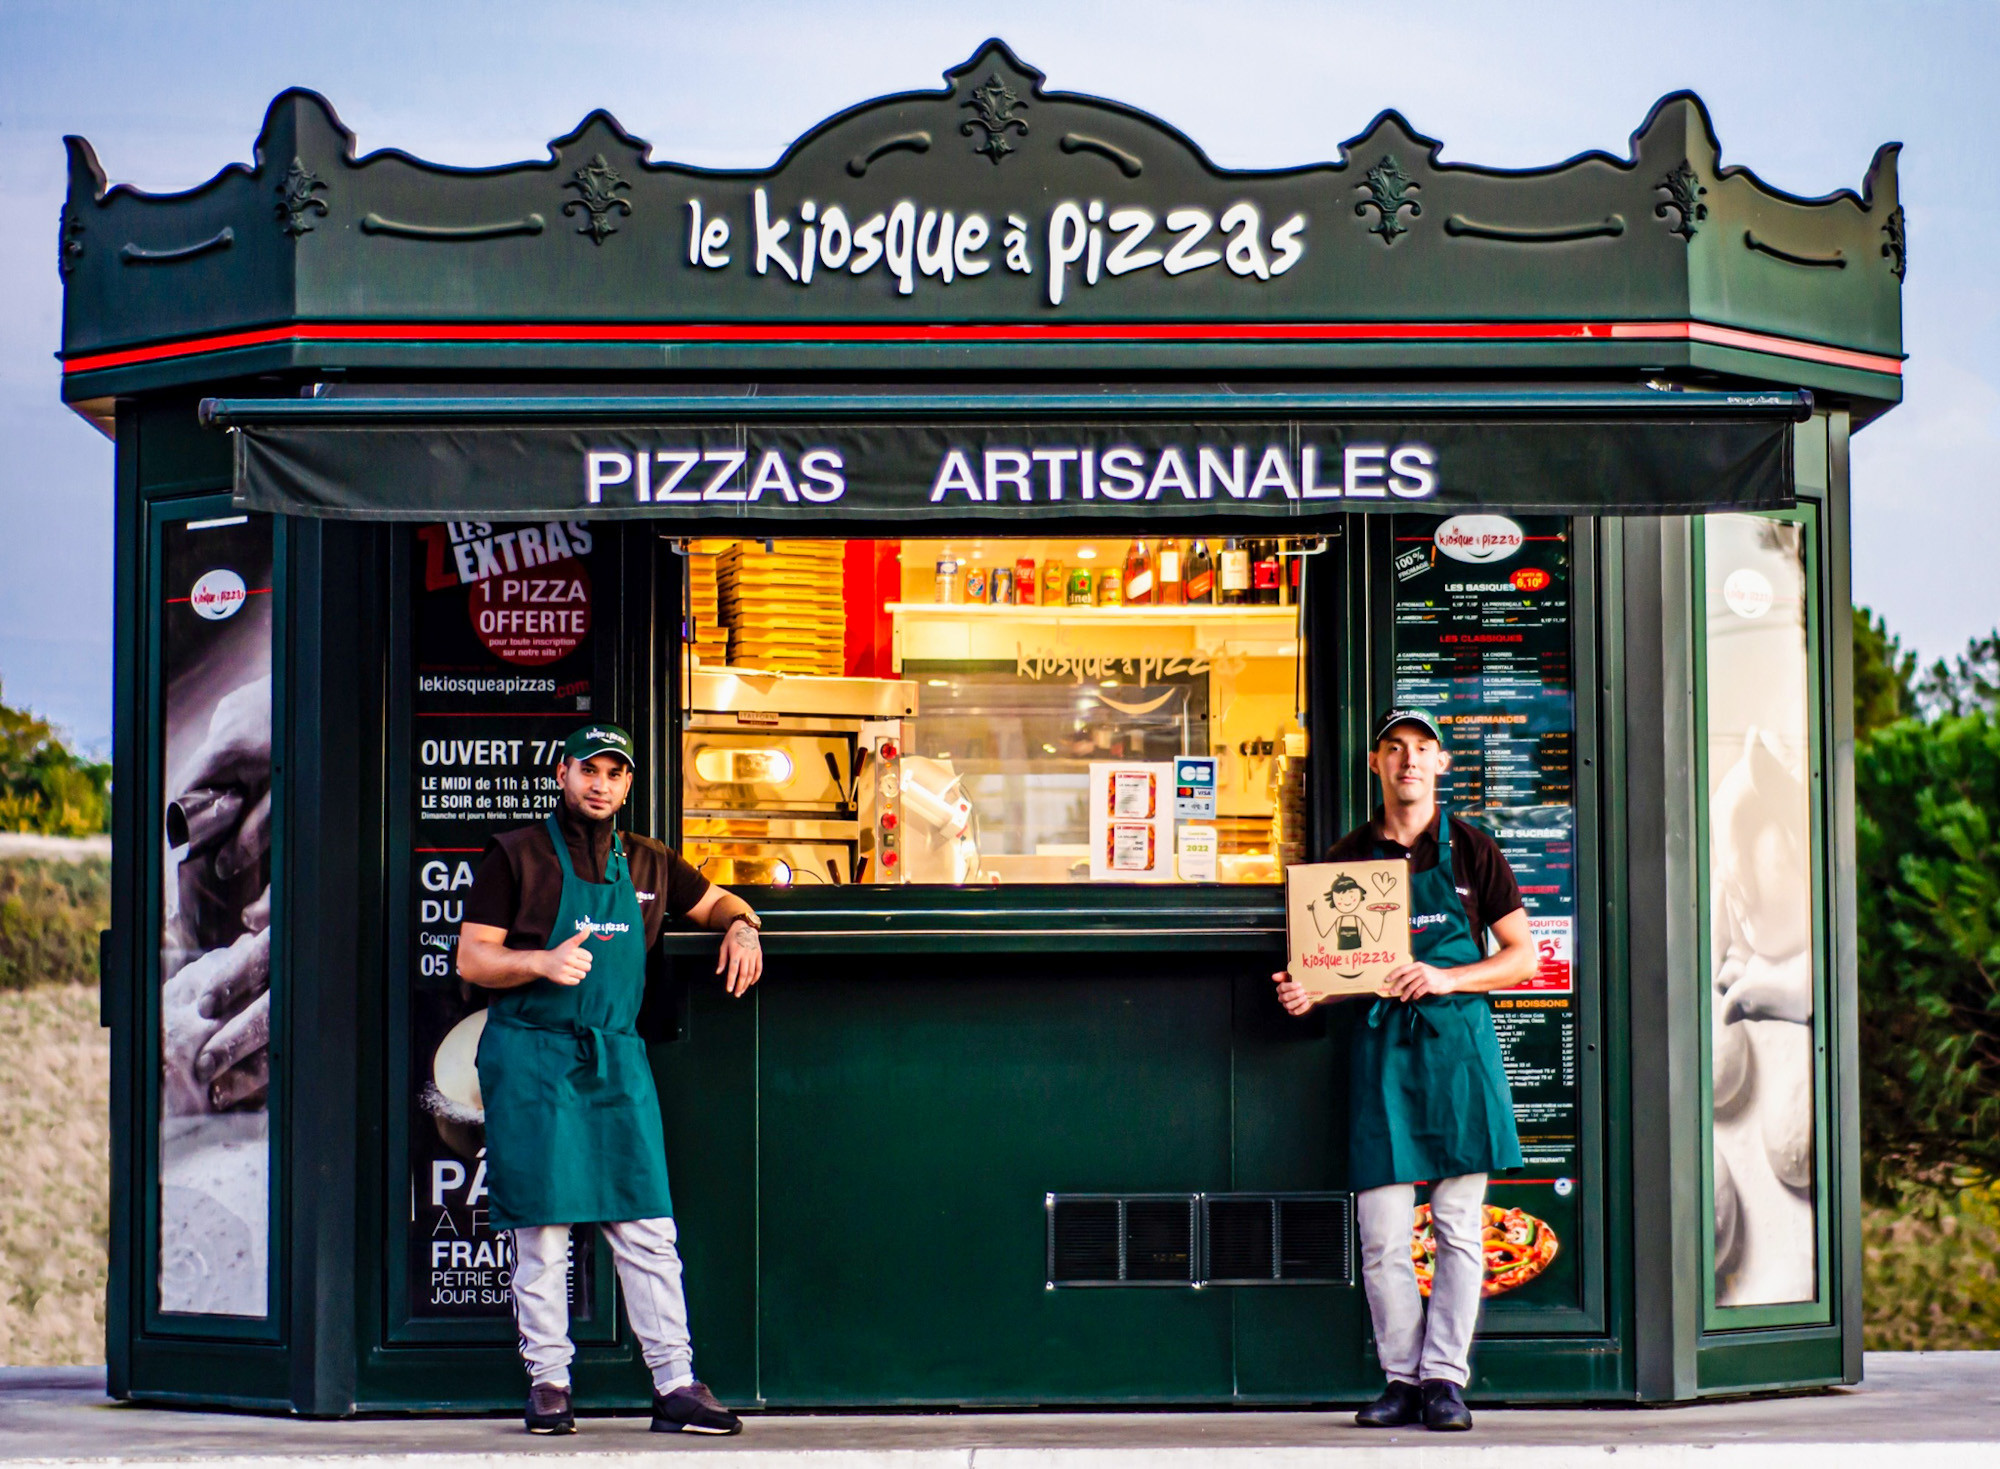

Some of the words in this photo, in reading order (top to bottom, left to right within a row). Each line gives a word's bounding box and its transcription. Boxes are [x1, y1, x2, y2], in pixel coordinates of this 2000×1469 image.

[689, 199, 731, 268] le
[755, 188, 990, 295] kiosque
[1003, 215, 1033, 275] à
[1049, 201, 1304, 305] pizzas
[587, 451, 845, 503] PIZZAS
[930, 447, 1436, 502] ARTISANALES
[447, 521, 493, 543] LES
[1438, 532, 1473, 548] kiosque
[1482, 534, 1520, 549] pizzas
[453, 520, 593, 584] EXTRAS
[480, 580, 491, 602] 1
[503, 580, 587, 602] PIZZA
[1445, 584, 1463, 592] LES
[1465, 584, 1516, 592] BASIQUES
[480, 610, 585, 633] OFFERTE
[533, 637, 576, 646] inscription
[1440, 635, 1458, 643] LES
[1461, 635, 1523, 643] CLASSIQUES
[518, 648, 539, 656] notre
[542, 648, 556, 656] site
[1017, 641, 1117, 685] kiosque
[1435, 715, 1453, 723] LES
[1455, 715, 1527, 724] GOURMANDES
[421, 740, 523, 765] OUVERT
[421, 777, 437, 790] LE
[441, 777, 471, 790] MIDI
[475, 777, 491, 790] de
[495, 777, 518, 790] 11h
[521, 776, 530, 790] à
[421, 795, 437, 808] LE
[441, 795, 472, 808] SOIR
[476, 795, 492, 808] de
[495, 795, 519, 808] 18h
[522, 794, 531, 808] à
[533, 795, 560, 808] 21h
[421, 812, 457, 820] Dimanche
[458, 812, 466, 820] et
[466, 812, 485, 821] jours
[487, 811, 507, 820] fériés
[513, 811, 534, 820] fermé
[535, 811, 543, 820] le
[1495, 829, 1513, 838] LES
[421, 900, 464, 923] DU
[420, 931, 461, 946] Comm
[420, 954, 449, 977] 05
[1302, 952, 1343, 971] kiosque
[1352, 950, 1396, 970] pizzas
[1494, 1000, 1513, 1008] LES
[1516, 999, 1569, 1008] BOISSONS
[431, 1267, 493, 1287] PÉTRIE
[431, 1286, 477, 1305] JOUR
